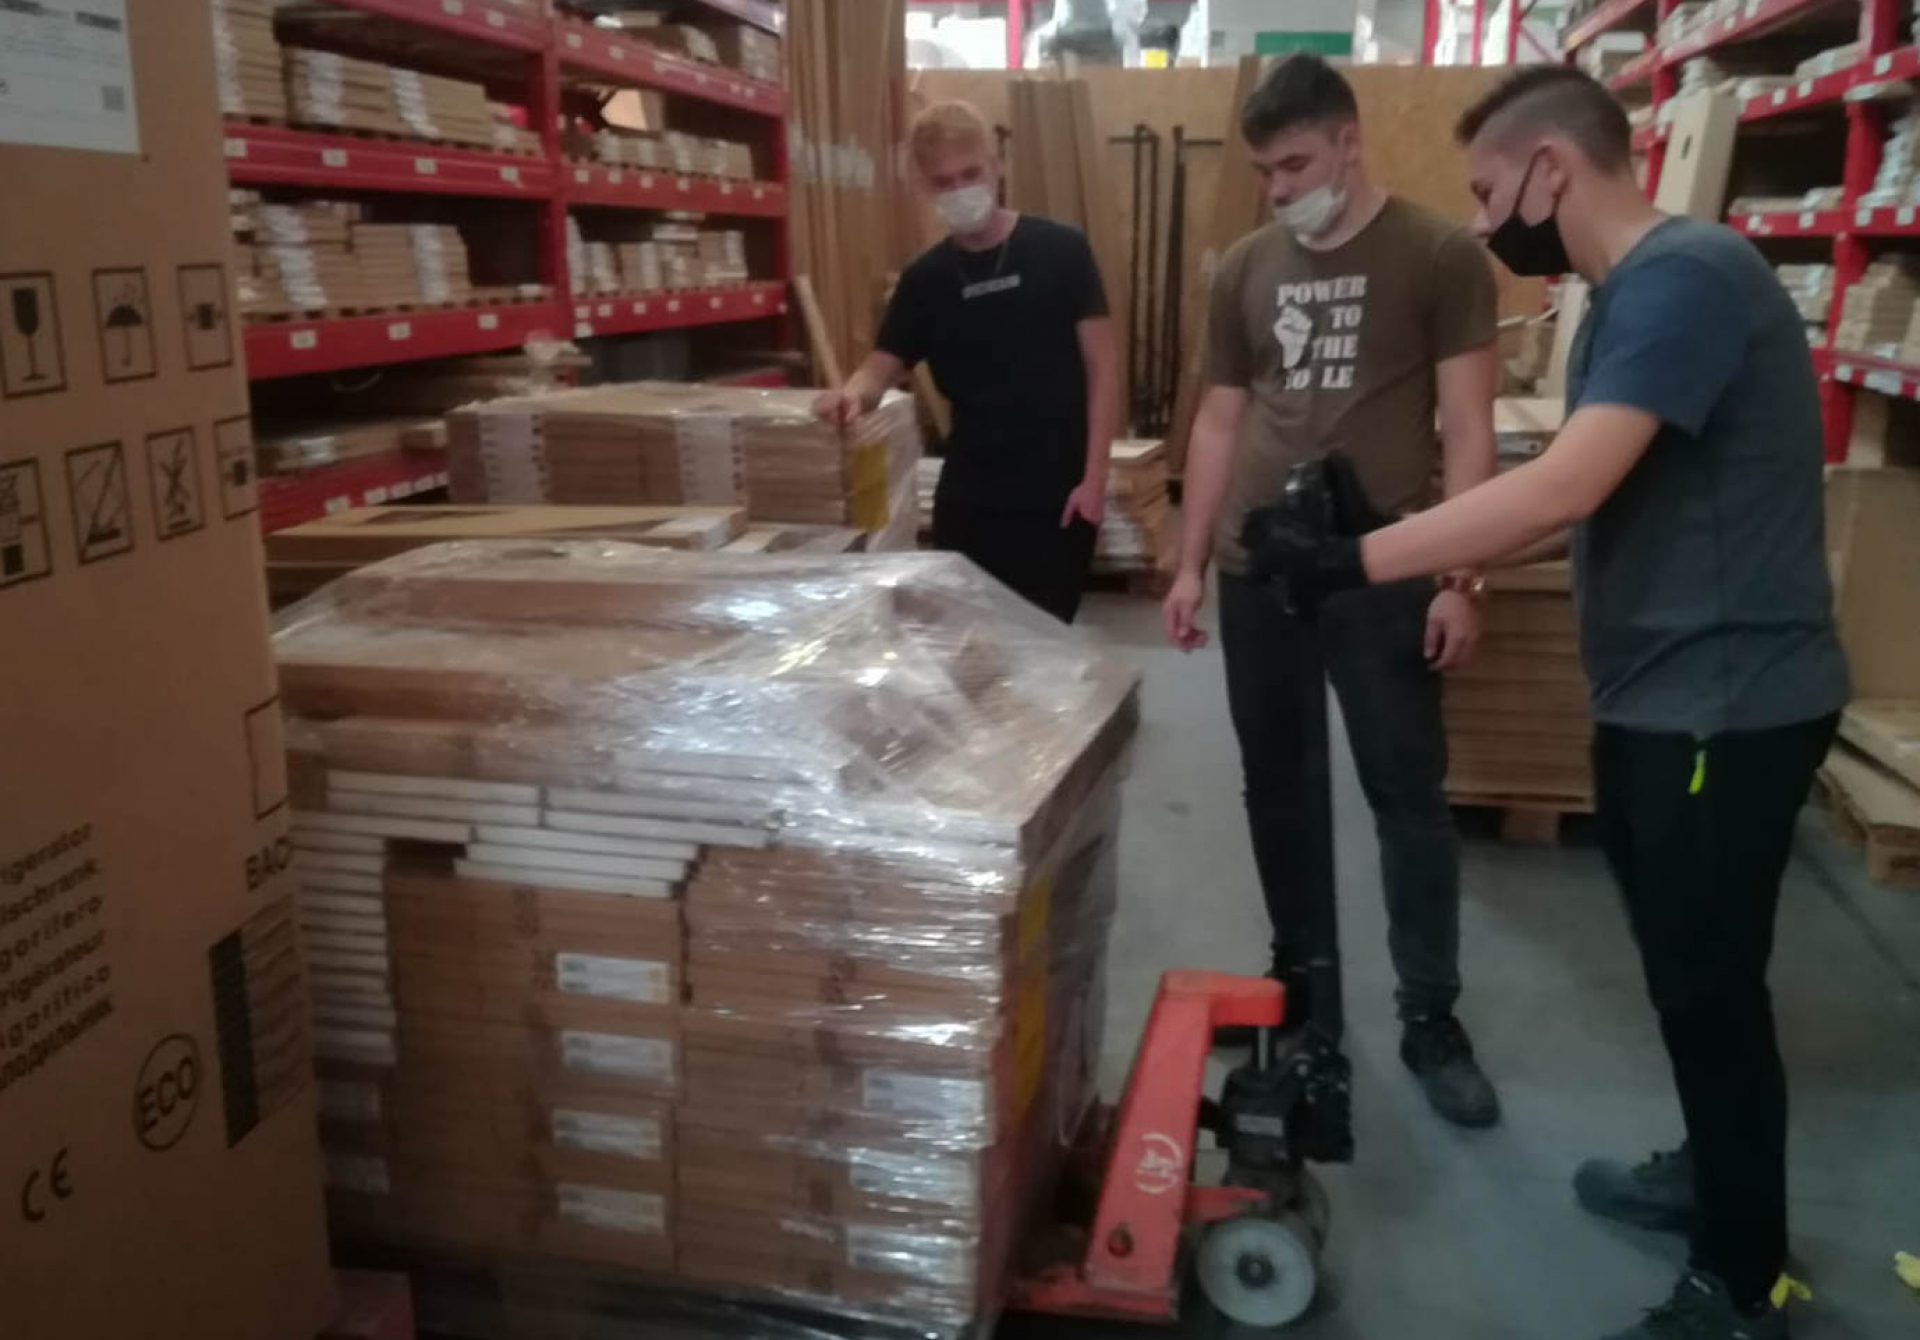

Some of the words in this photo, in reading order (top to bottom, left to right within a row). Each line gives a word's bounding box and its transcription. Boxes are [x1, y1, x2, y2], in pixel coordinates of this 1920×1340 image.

[1277, 275, 1367, 308] POWER
[1330, 304, 1362, 329] TO
[138, 1055, 197, 1133] ECO
